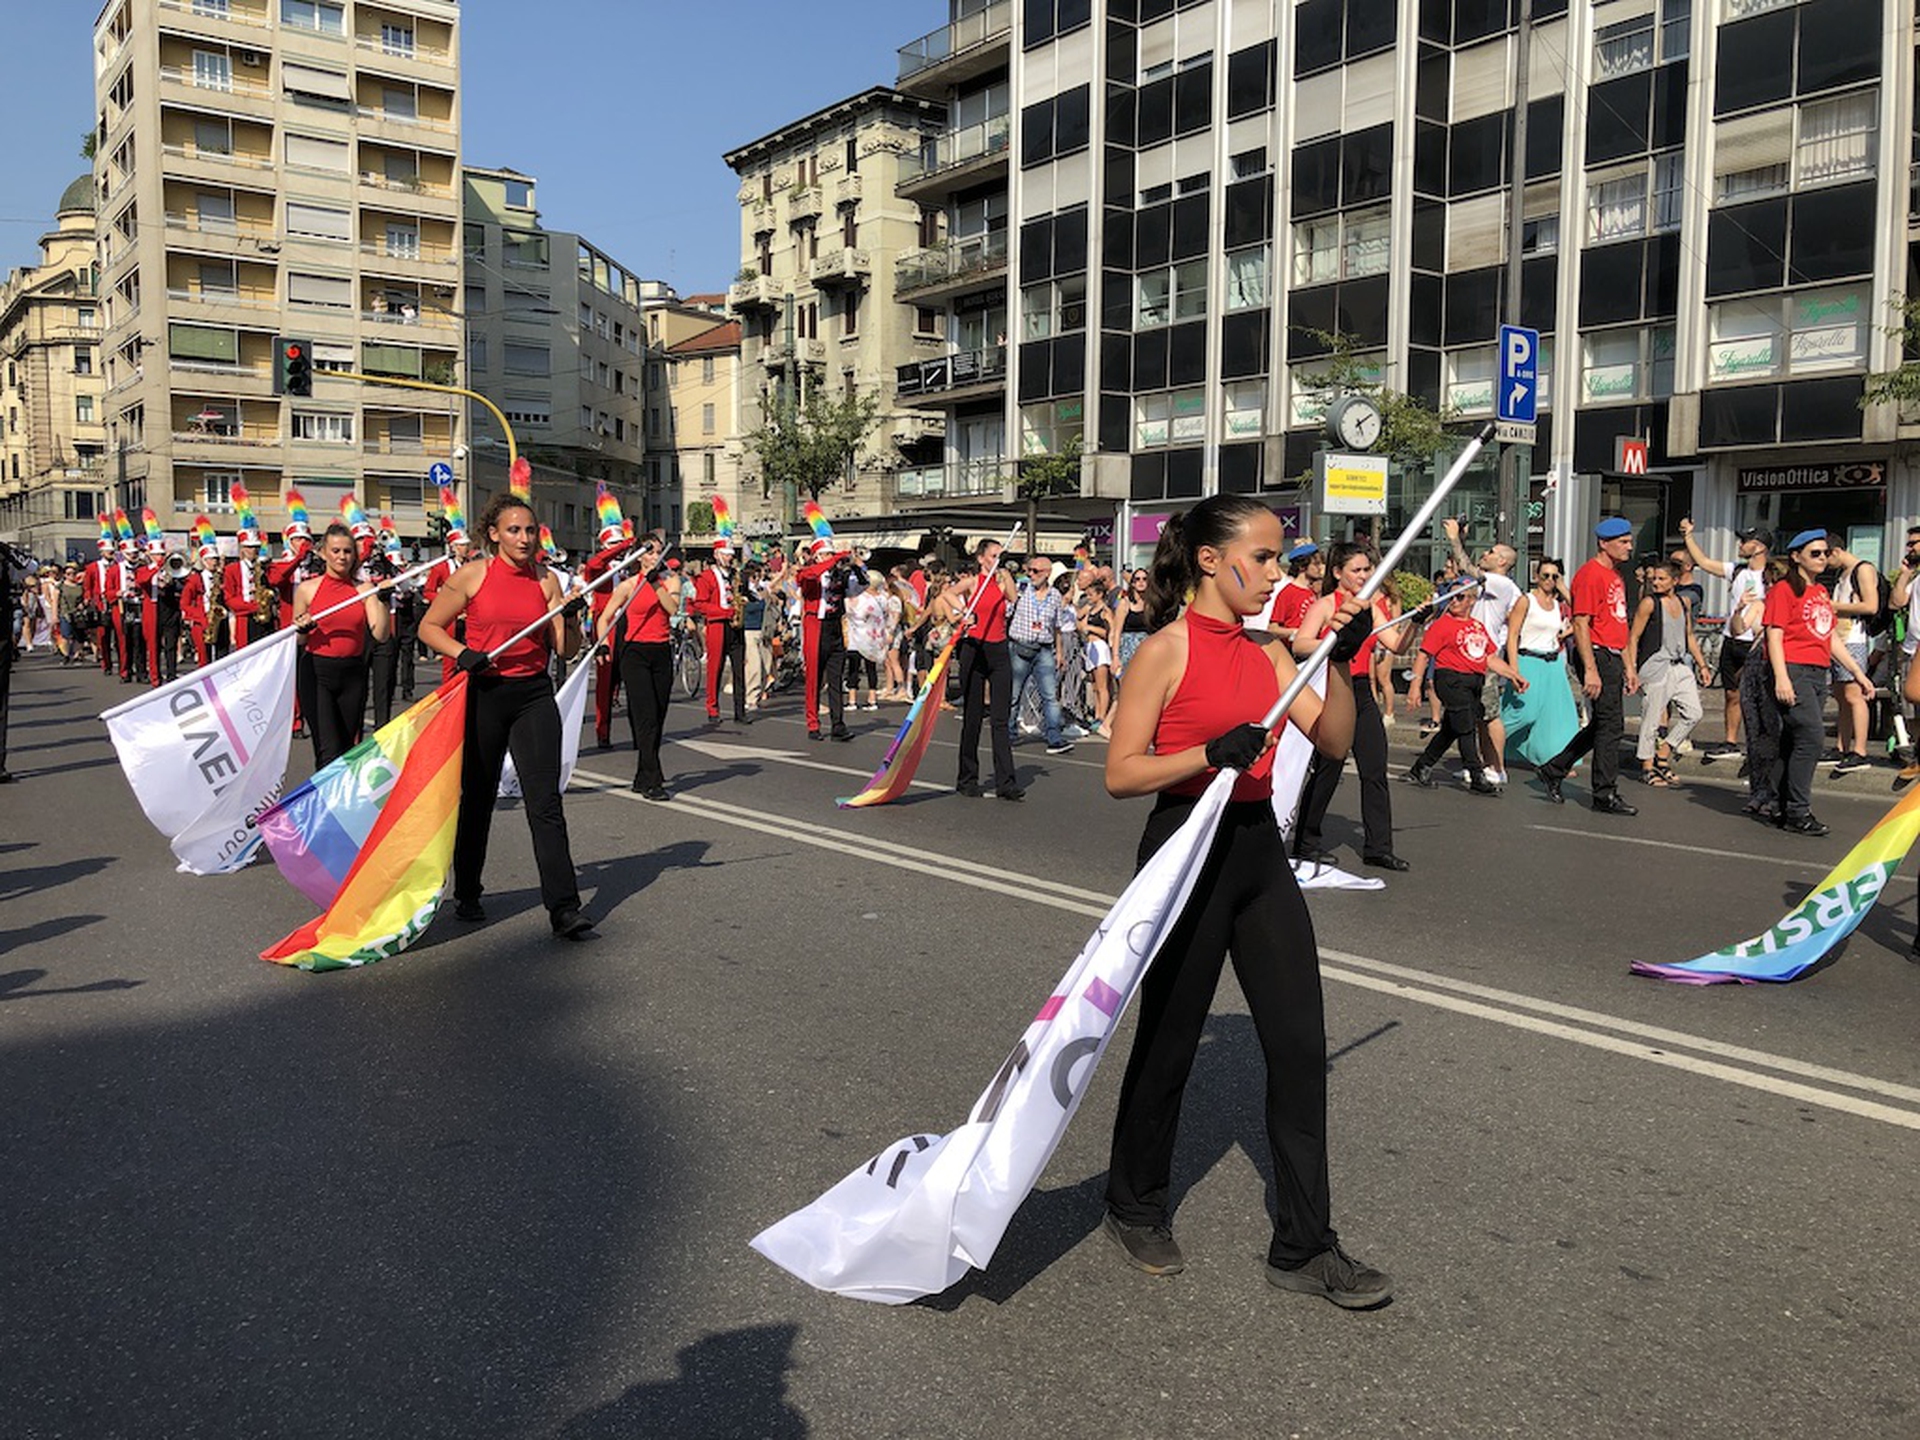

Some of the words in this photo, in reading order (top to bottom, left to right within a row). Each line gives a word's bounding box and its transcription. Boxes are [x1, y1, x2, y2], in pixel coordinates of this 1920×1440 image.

[1507, 333, 1530, 377] P
[1623, 448, 1645, 474] M
[1742, 469, 1829, 487] VisionOttica
[169, 686, 238, 797] DIVE
